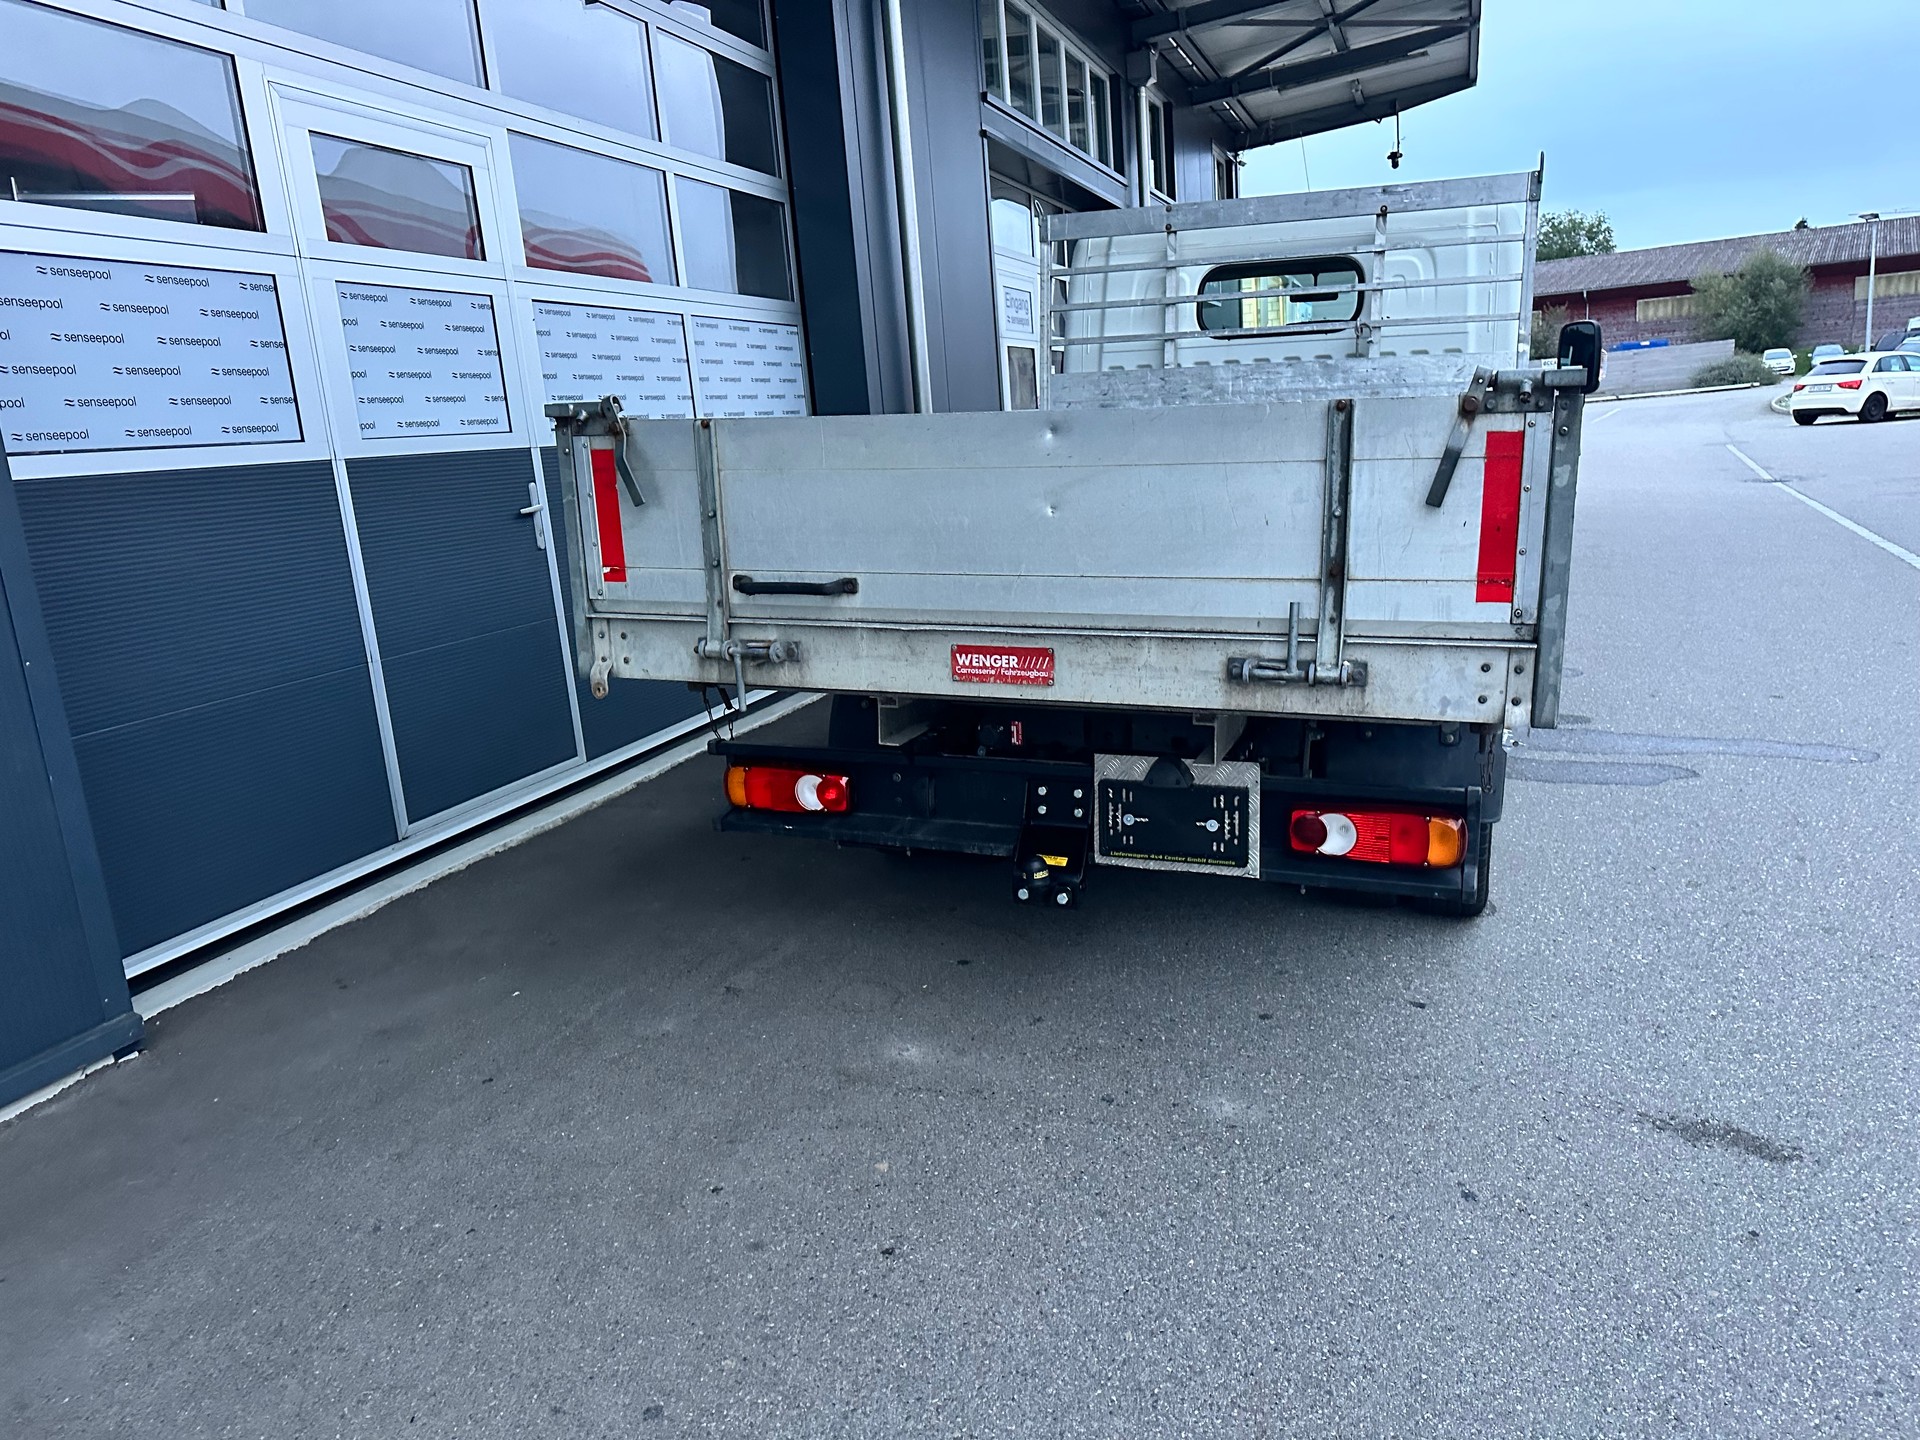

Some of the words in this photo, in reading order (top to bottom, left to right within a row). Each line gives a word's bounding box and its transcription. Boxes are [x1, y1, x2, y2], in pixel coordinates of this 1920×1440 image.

[50, 266, 112, 280] senseepool
[156, 274, 210, 288] senseepool
[349, 292, 388, 303] senseepool
[417, 298, 452, 308] senseepool
[112, 302, 170, 316] senseepool
[1005, 292, 1029, 315] Eingang
[210, 309, 259, 320] senseepool
[388, 321, 425, 331] senseepool
[451, 324, 485, 333] senseepool
[64, 332, 125, 345] senseepool
[169, 336, 221, 348] senseepool
[357, 345, 396, 355] senseepool
[424, 348, 459, 356] senseepool
[11, 364, 76, 377] senseepool
[125, 366, 181, 378] senseepool
[221, 367, 270, 378] senseepool
[396, 371, 432, 380] senseepool
[458, 372, 492, 380] senseepool
[77, 396, 137, 409] senseepool
[180, 396, 232, 407] senseepool
[366, 396, 404, 405] senseepool
[432, 395, 466, 404] senseepool
[404, 420, 440, 428] senseepool
[466, 418, 499, 426] senseepool
[137, 426, 192, 439] senseepool
[232, 424, 279, 435] senseepool
[25, 429, 89, 442] senseepool
[955, 654, 1019, 668] WENGER
[955, 666, 995, 675] Carrosserie
[1001, 669, 1048, 678] Fahrzeugbau
[1110, 851, 1149, 859] Lieferwagen
